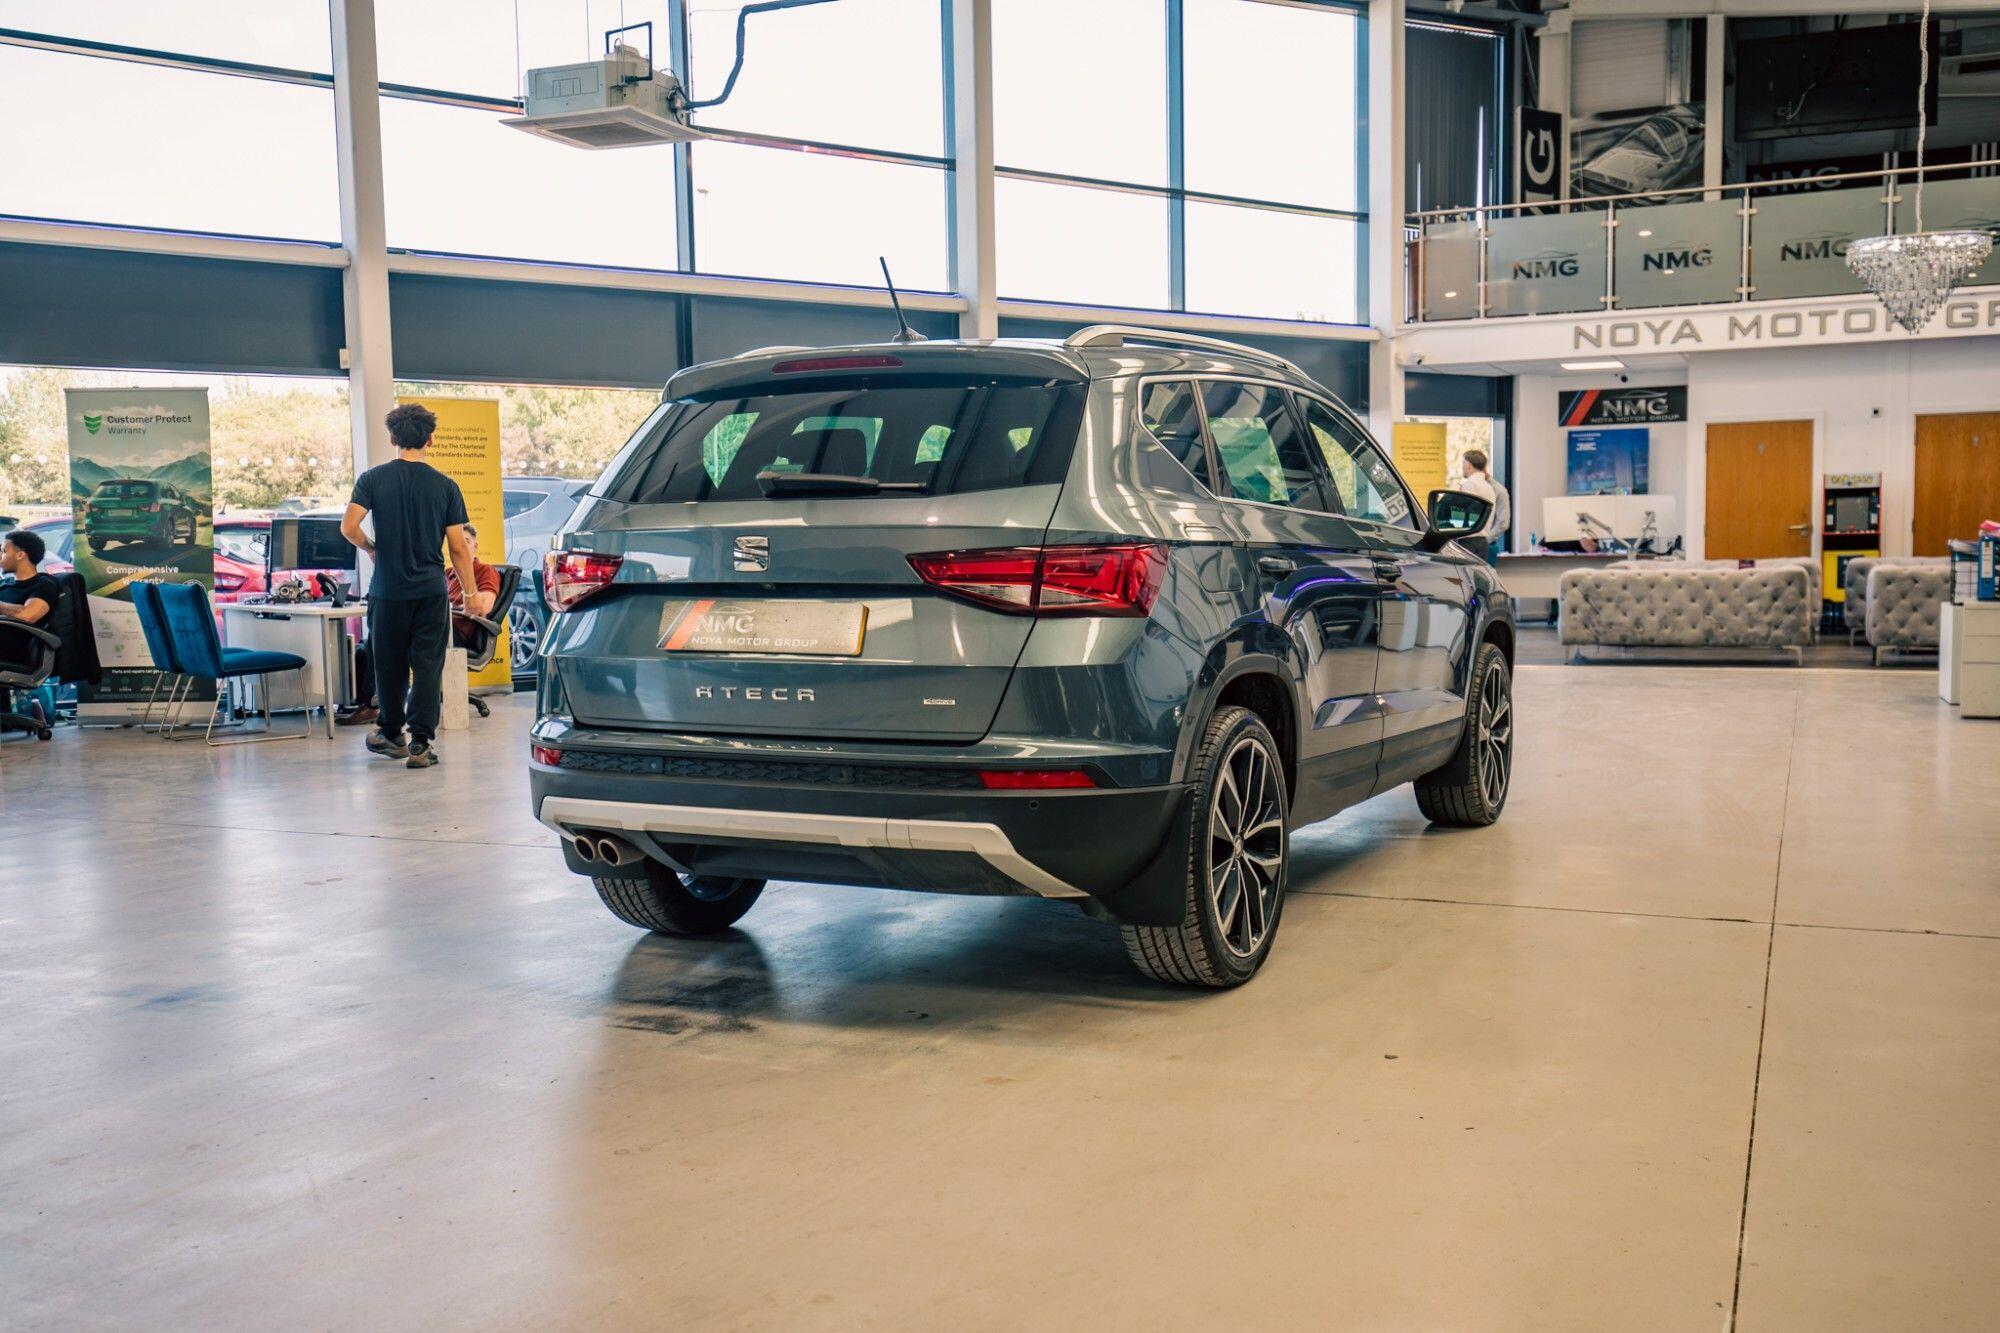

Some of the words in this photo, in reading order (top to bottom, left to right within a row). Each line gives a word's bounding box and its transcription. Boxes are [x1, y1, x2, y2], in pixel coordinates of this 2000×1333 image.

[1643, 250, 1712, 271] NMG
[1513, 259, 1579, 279] NMG
[1574, 318, 1702, 349] NOYA
[1602, 398, 1669, 417] NMG
[107, 415, 153, 424] Customer
[155, 414, 192, 423] Protect
[1616, 415, 1647, 423] MOTOR
[1650, 413, 1680, 421] GROUP
[107, 427, 147, 435] Warranty
[106, 565, 179, 576] Comprehensive
[696, 614, 755, 634] NMG
[691, 636, 723, 645] NOYA
[727, 637, 771, 646] MOTOR
[774, 637, 819, 648] GROUP
[696, 686, 816, 702] ATECA
